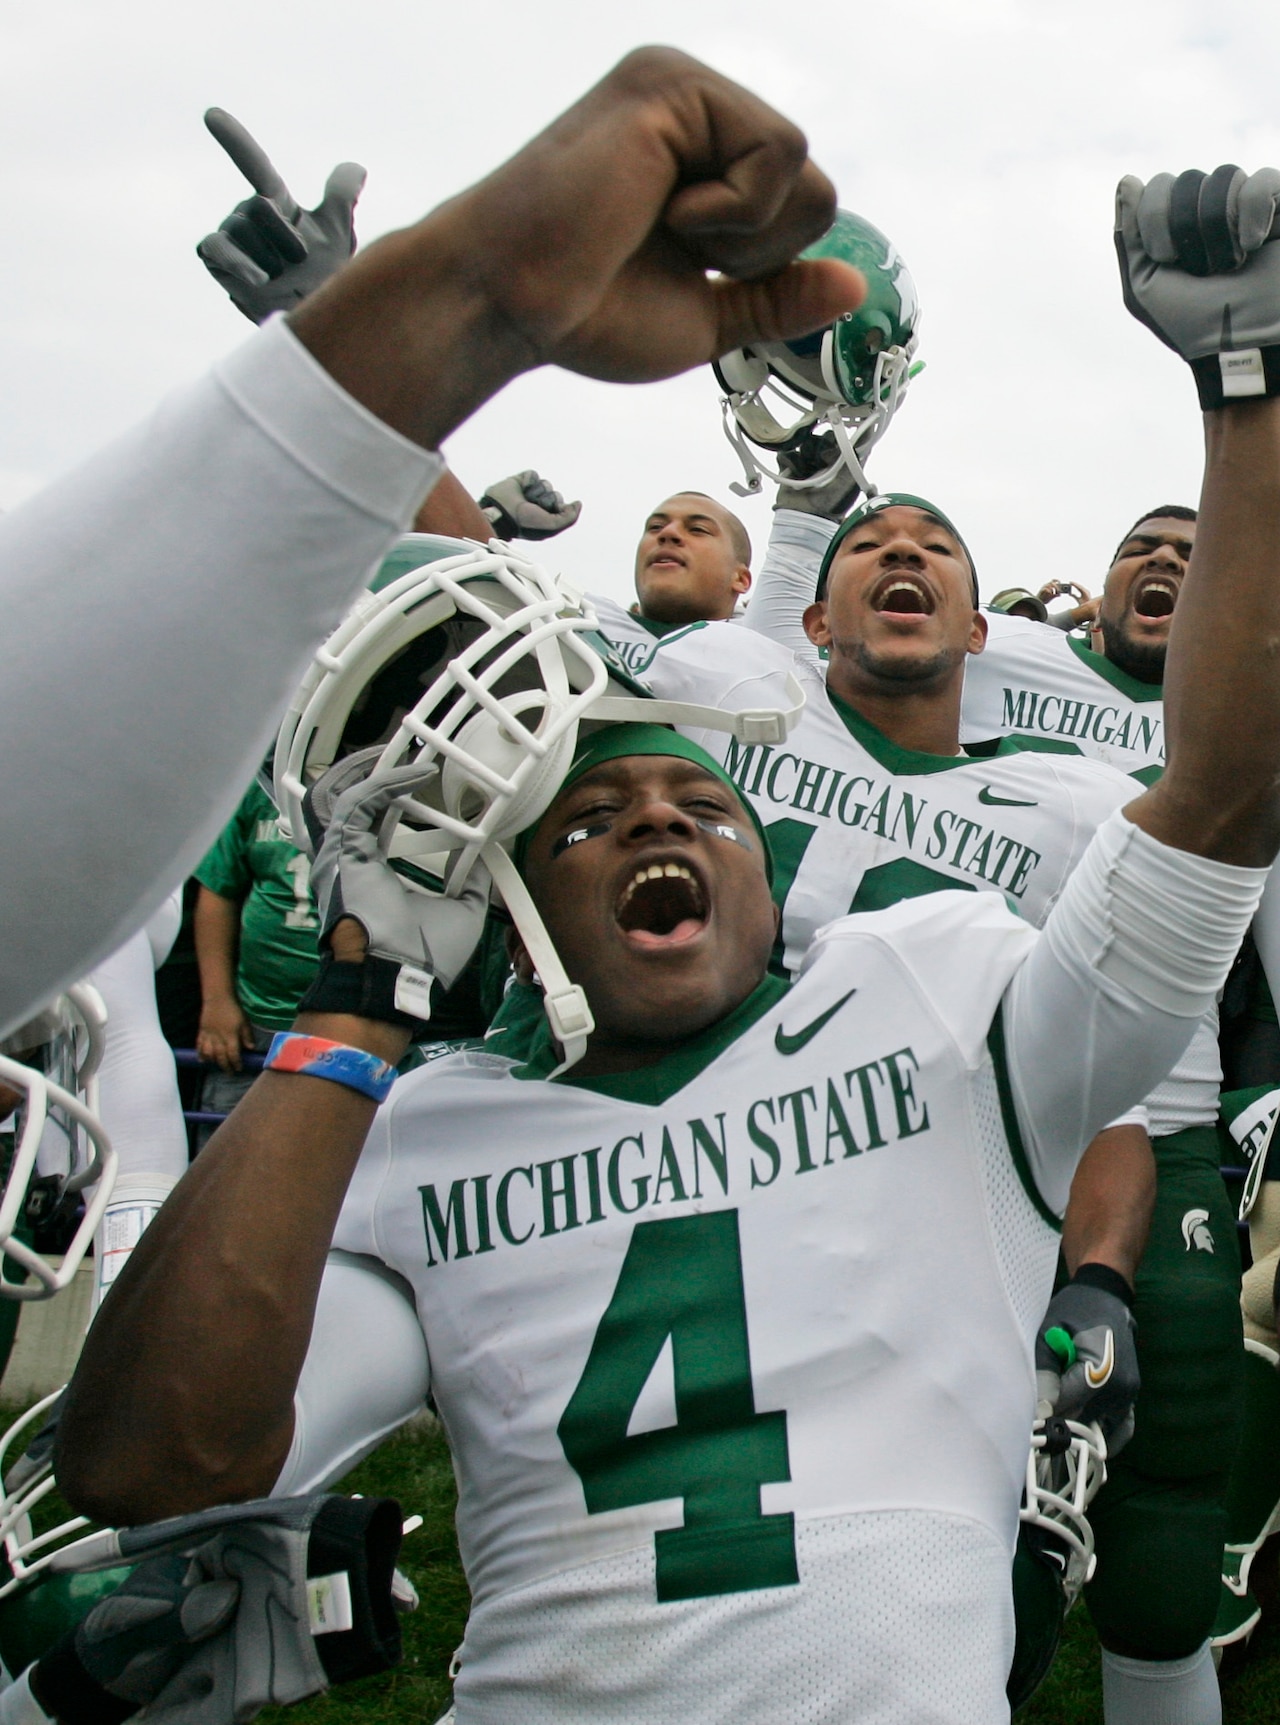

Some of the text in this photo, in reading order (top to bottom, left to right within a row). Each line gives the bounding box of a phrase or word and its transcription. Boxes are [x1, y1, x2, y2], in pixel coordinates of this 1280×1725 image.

[723, 736, 927, 850] MICHIGAN
[925, 809, 1042, 898] STATE
[1001, 688, 1161, 754] MICHIGAN
[417, 1046, 931, 1269] MICHIGAN STATE
[556, 1207, 801, 1605] 4
